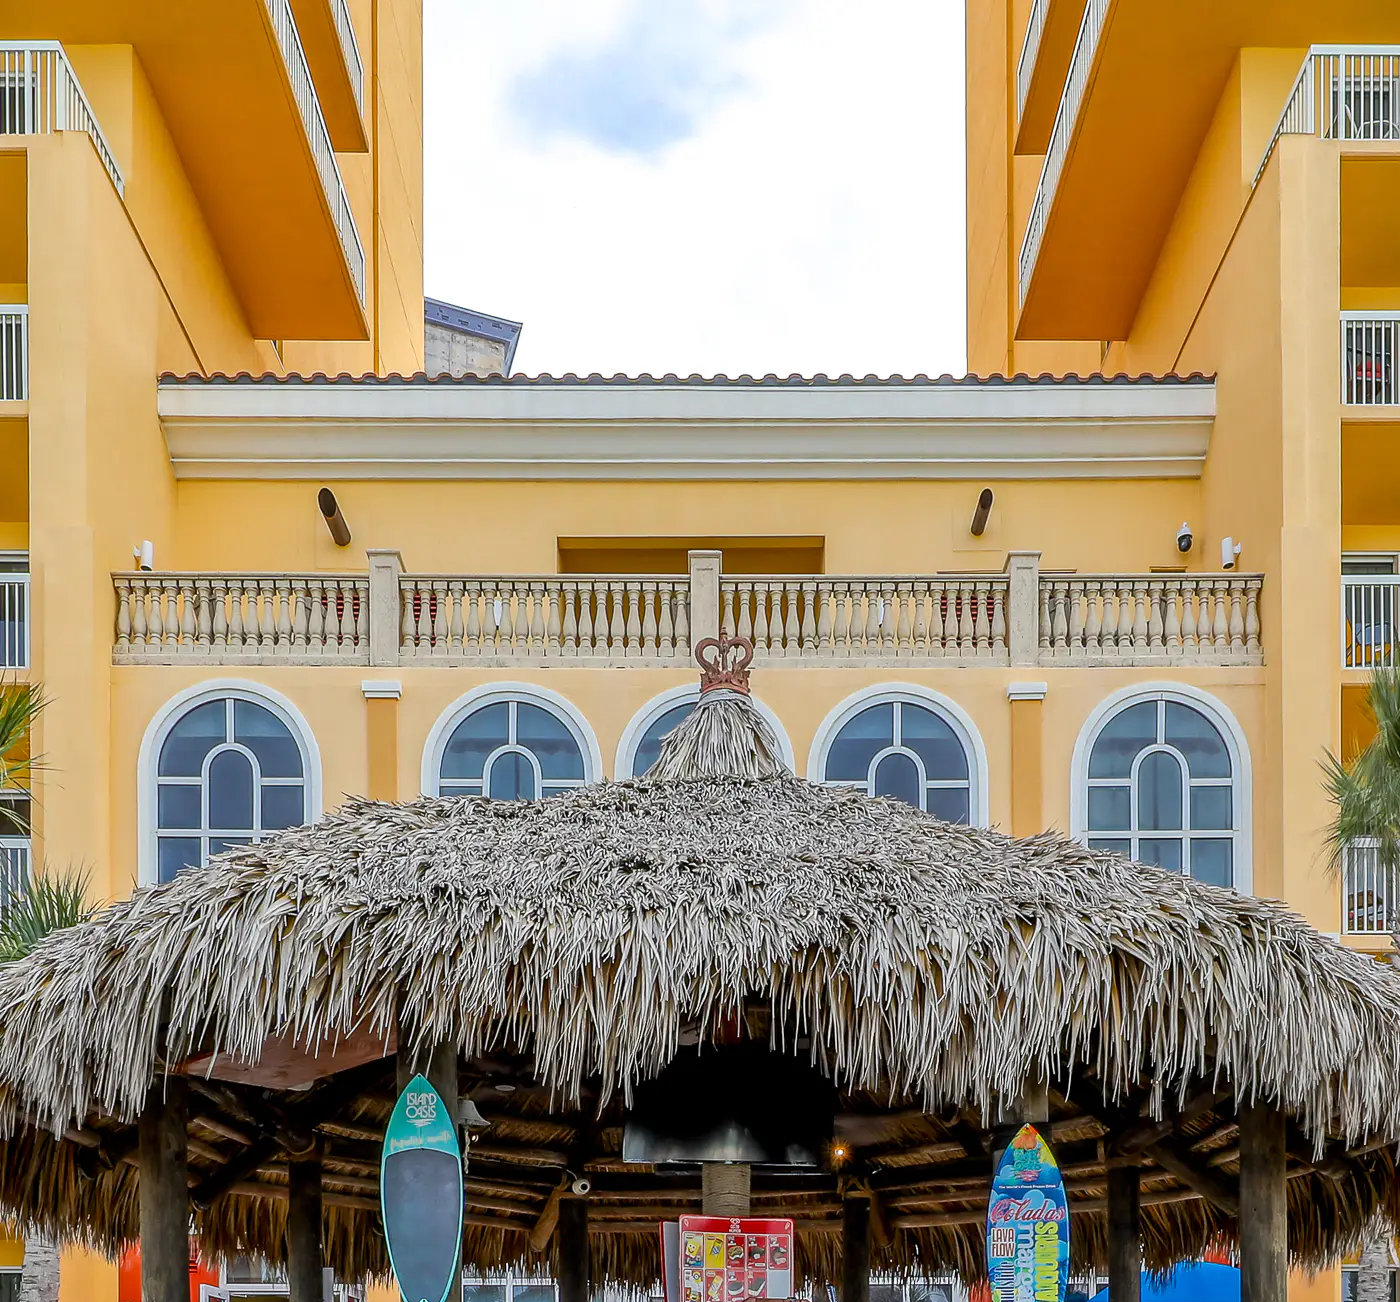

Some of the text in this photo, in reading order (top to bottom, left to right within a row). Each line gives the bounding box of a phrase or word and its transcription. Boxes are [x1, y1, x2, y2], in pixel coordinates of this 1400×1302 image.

[406, 1092, 437, 1106] ISLAND
[405, 1105, 437, 1119] OASIS
[990, 1197, 1065, 1223] Coladas
[991, 1227, 1015, 1242] LAVA
[991, 1242, 1015, 1257] FLOW
